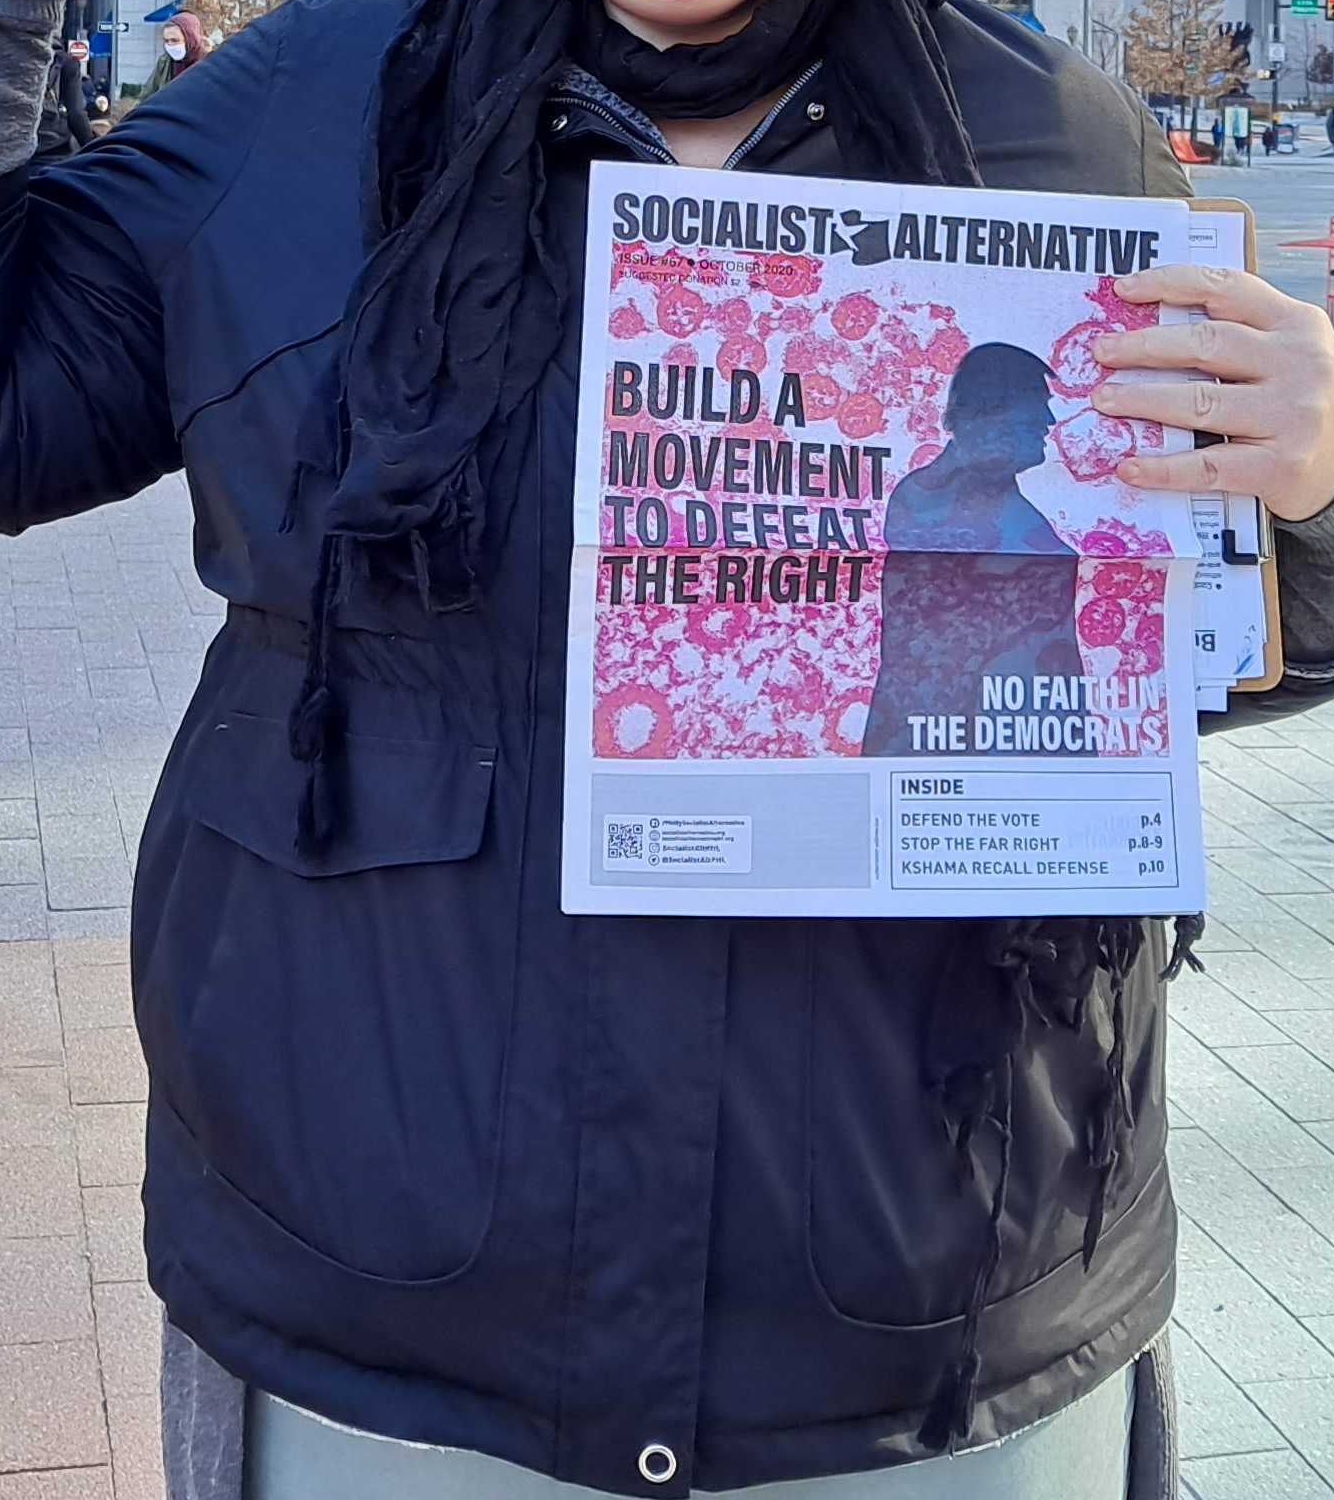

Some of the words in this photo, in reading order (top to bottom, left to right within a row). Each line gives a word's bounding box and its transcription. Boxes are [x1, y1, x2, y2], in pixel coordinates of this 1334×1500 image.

[612, 192, 835, 253] SOCIALIST
[619, 252, 660, 267] ISSUE
[699, 259, 761, 273] OCTOBER
[764, 264, 794, 277] 2020
[678, 274, 728, 286] DONATION
[611, 361, 762, 425] BUILD
[773, 372, 806, 428] A
[608, 430, 892, 501] MOVEMENT
[604, 495, 668, 548] TO
[685, 499, 872, 550] DEFEAT
[602, 555, 701, 606] THE
[716, 555, 873, 605] RIGHT
[982, 674, 1025, 711] NO
[1033, 674, 1119, 711] FAITH
[1128, 675, 1160, 711] IN
[907, 715, 968, 751] THE
[974, 715, 1163, 751] DEMOCRATS
[900, 779, 965, 796] INSIDE
[900, 812, 964, 828] DEFEND
[967, 813, 997, 828] THE
[1002, 813, 1041, 828] VOTE
[1141, 812, 1162, 829] p.4
[900, 837, 940, 852] STOP
[946, 837, 976, 852] THE
[979, 837, 1009, 852] FAR
[1013, 837, 1060, 852] RIGHT
[1128, 836, 1163, 853] p.8-9
[901, 861, 968, 876] KSHAMA
[972, 861, 1033, 876] RECALL
[1037, 861, 1110, 876] DEFENSE
[1139, 860, 1165, 877] p.10
